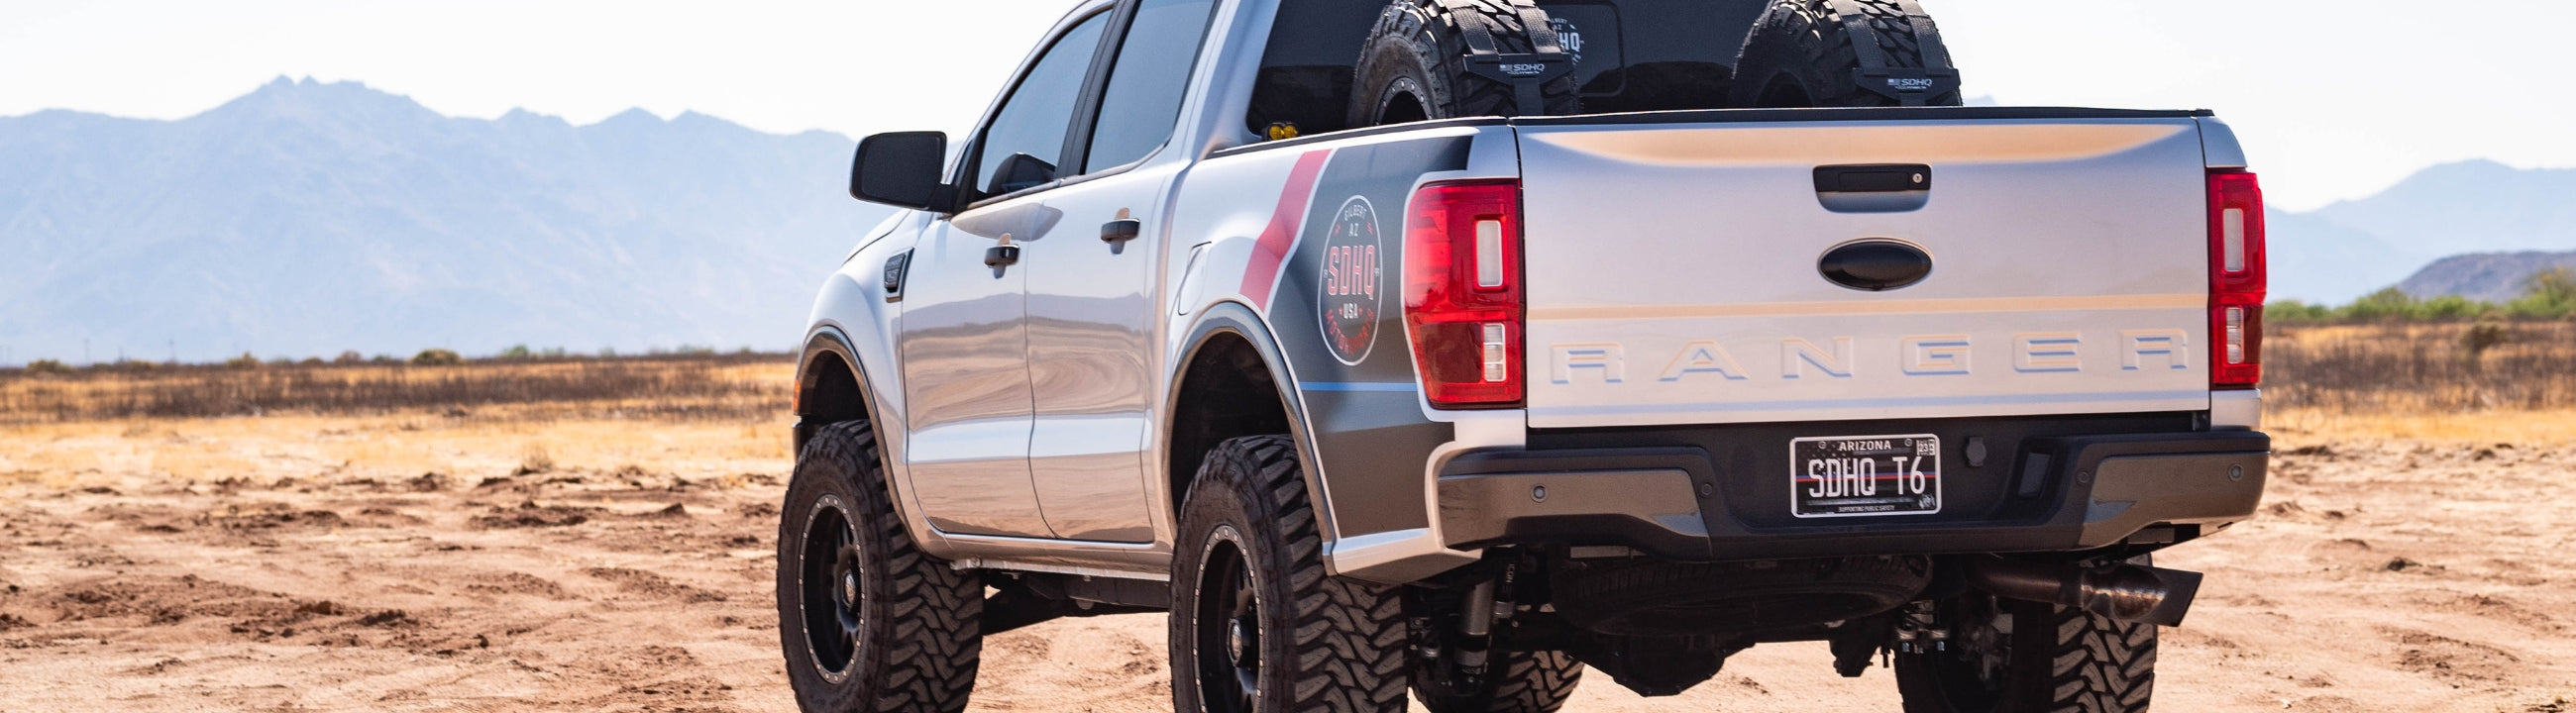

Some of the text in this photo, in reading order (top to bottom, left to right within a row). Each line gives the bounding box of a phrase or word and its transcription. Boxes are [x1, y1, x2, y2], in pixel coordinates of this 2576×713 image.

[1558, 32, 1581, 52] HQ
[1513, 63, 1546, 72] SDHQ
[1901, 78, 1933, 87] SDHQ
[1348, 223, 1359, 237] AZ
[1328, 245, 1375, 300] SDHQ
[1342, 303, 1358, 319] USA
[1551, 328, 2189, 385] RANGER
[1839, 440, 1892, 452] ARIZONA
[1808, 456, 1926, 498] SDHQ T6
